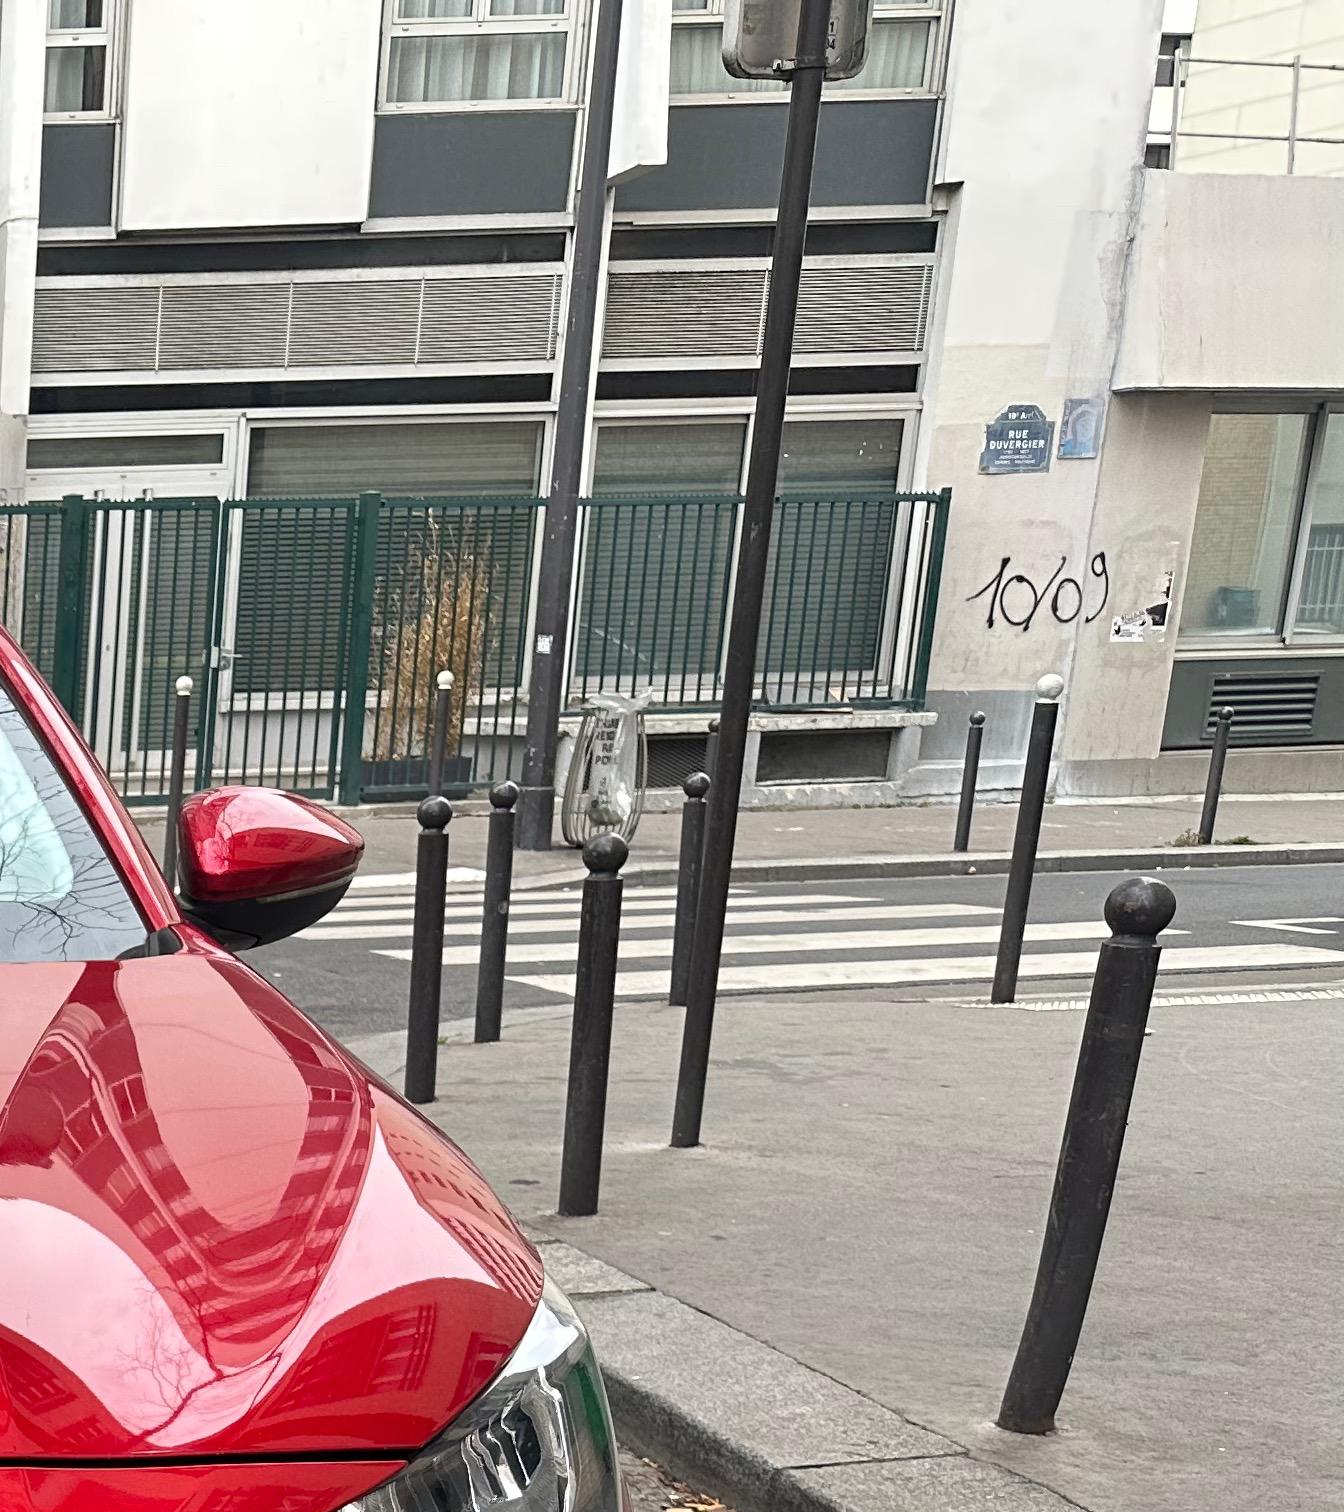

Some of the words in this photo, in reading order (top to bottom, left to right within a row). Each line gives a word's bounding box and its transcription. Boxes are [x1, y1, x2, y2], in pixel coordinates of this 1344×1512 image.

[1008, 429, 1029, 439] RUE
[989, 439, 1045, 450] DUVERGIER
[965, 551, 1109, 632] 10/09
